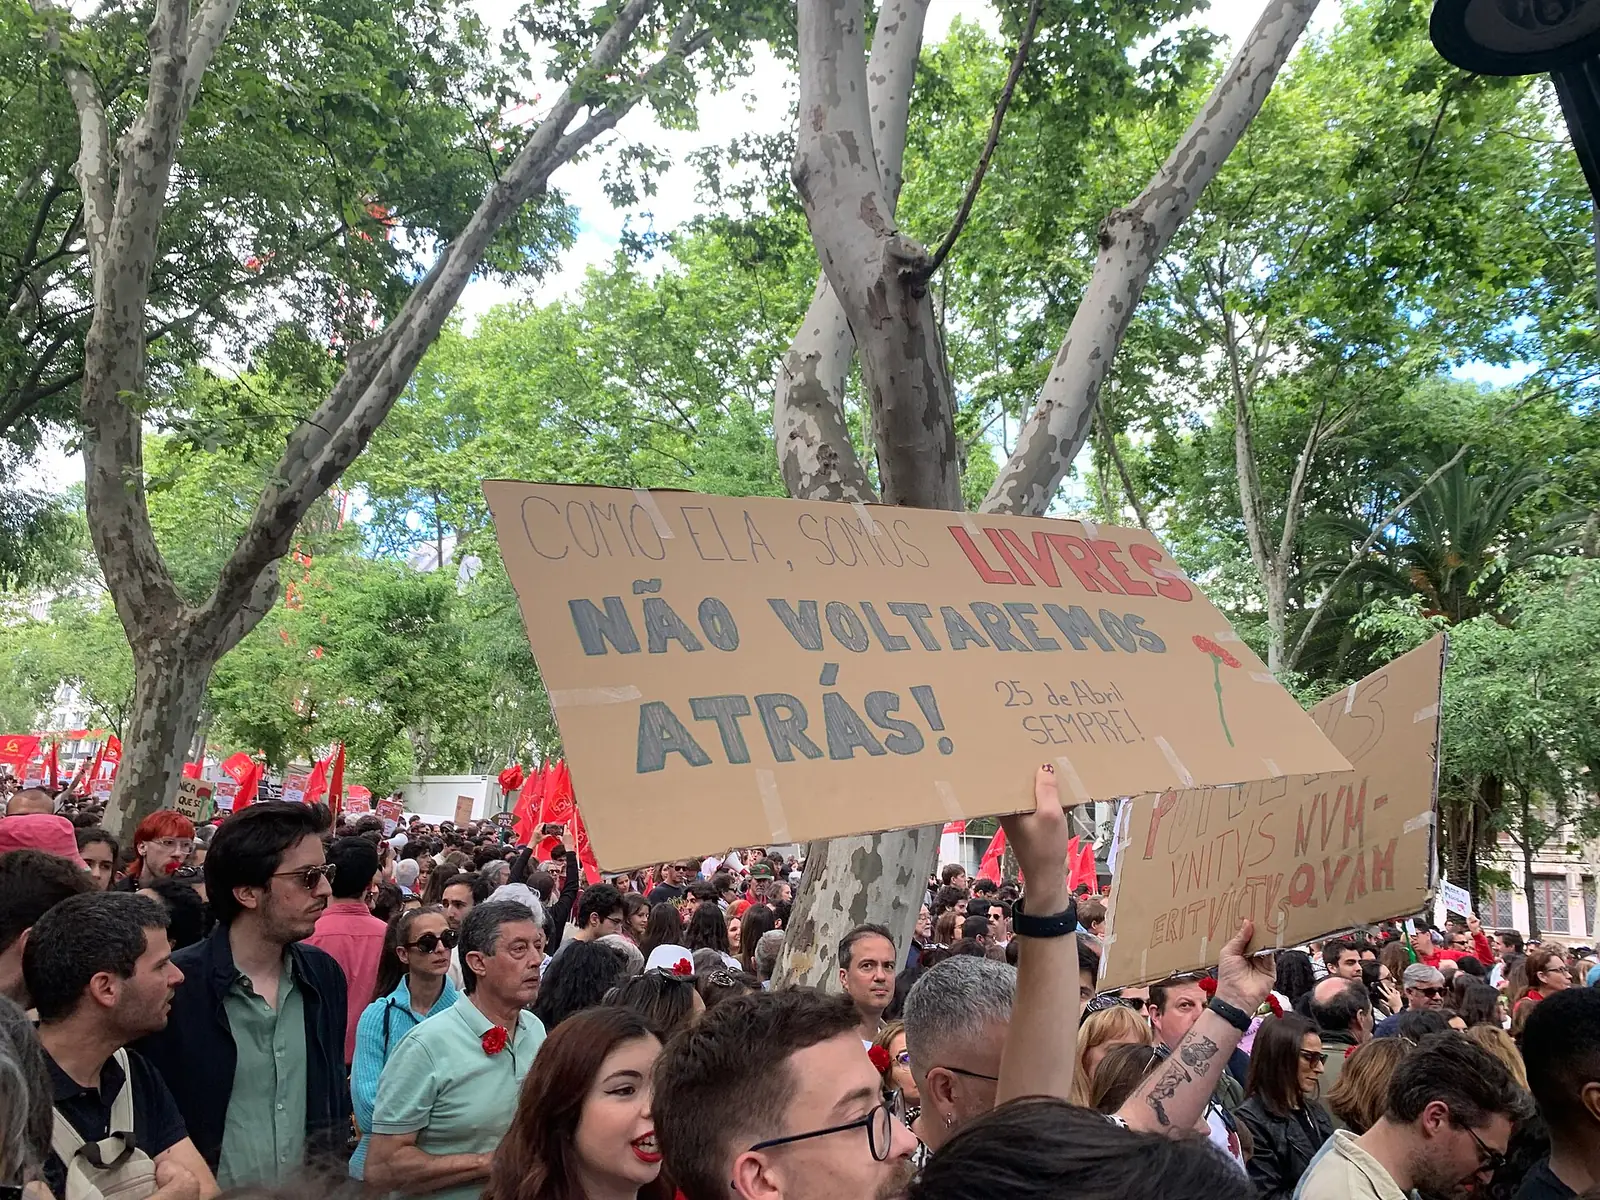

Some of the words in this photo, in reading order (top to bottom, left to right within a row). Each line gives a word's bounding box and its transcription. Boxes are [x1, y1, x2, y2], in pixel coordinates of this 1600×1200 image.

[520, 494, 666, 561] COMO
[680, 505, 793, 572] ELA,
[797, 512, 931, 568] SOMOS
[947, 525, 1193, 603] LIVRES
[568, 577, 741, 656] NÃO
[766, 600, 1167, 654] VOLTAREMOS
[635, 662, 955, 774] ATRÁS!
[994, 680, 1034, 708] 25
[1047, 682, 1073, 707] de
[1071, 678, 1125, 705] Abril
[1022, 707, 1146, 746] SEMPRE!
[498, 819, 513, 827] PAZ
